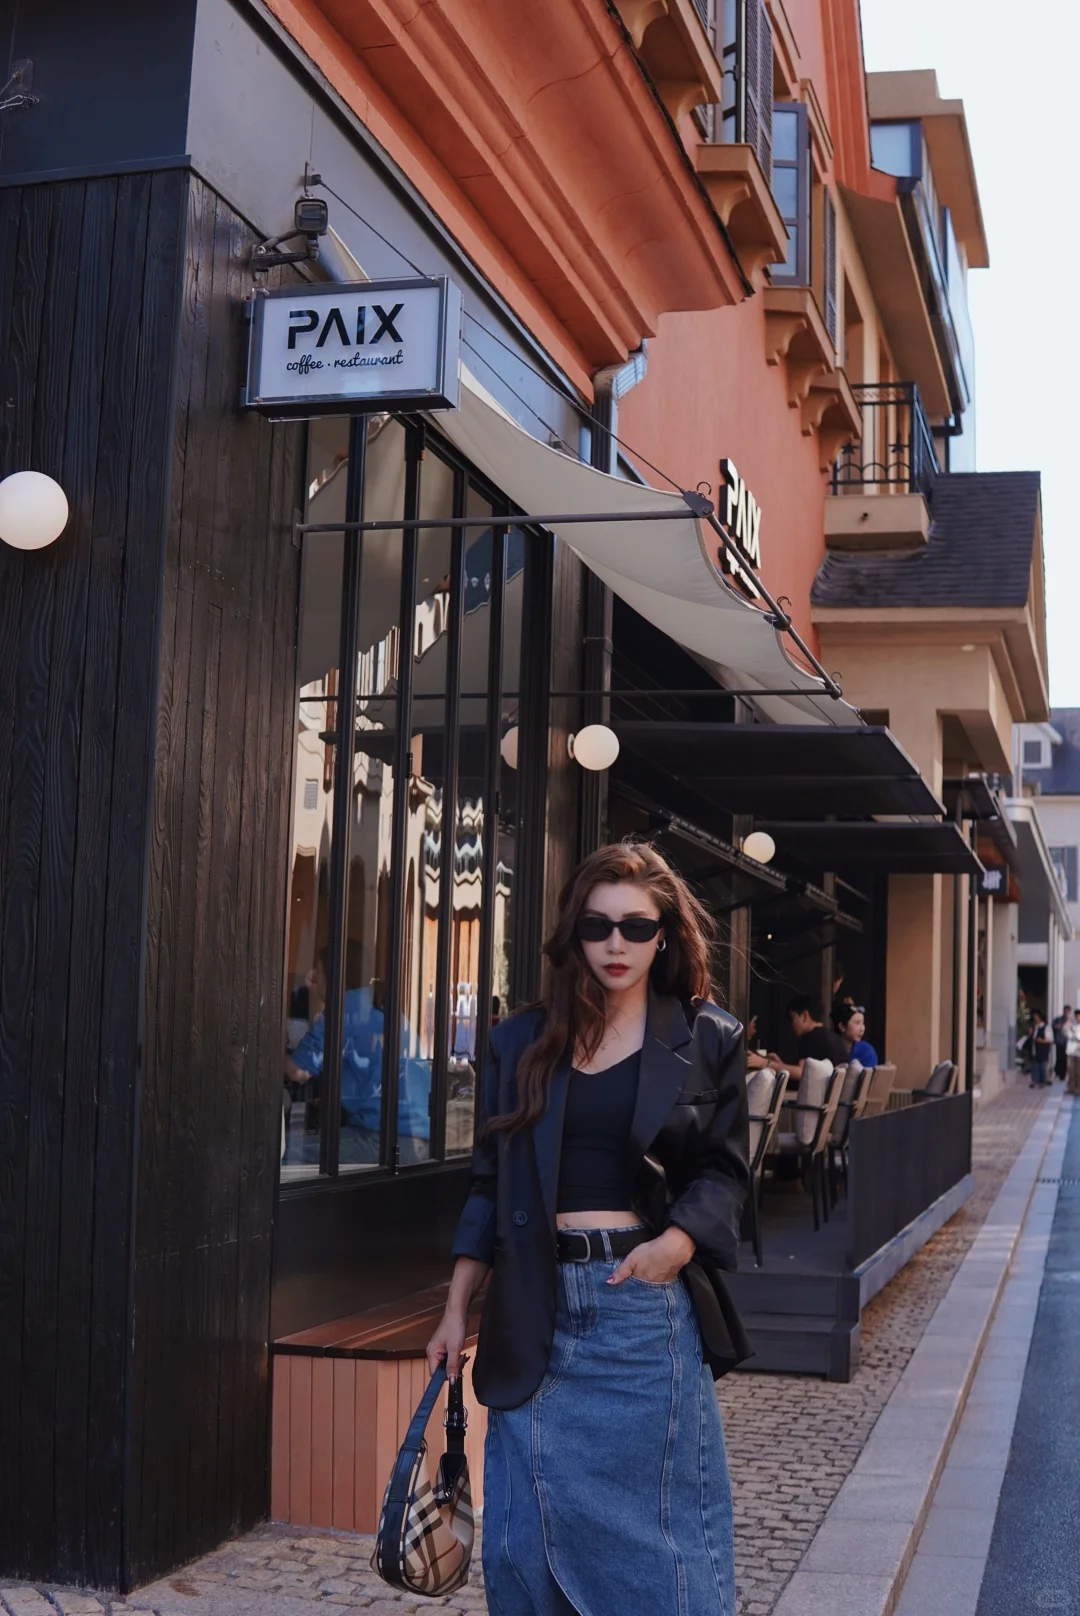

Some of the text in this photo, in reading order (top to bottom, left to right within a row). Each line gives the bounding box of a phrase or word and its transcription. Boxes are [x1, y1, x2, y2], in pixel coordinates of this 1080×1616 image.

[287, 303, 405, 350] PAIX
[286, 349, 404, 375] coffee restaurant
[724, 457, 762, 570] PAIX
